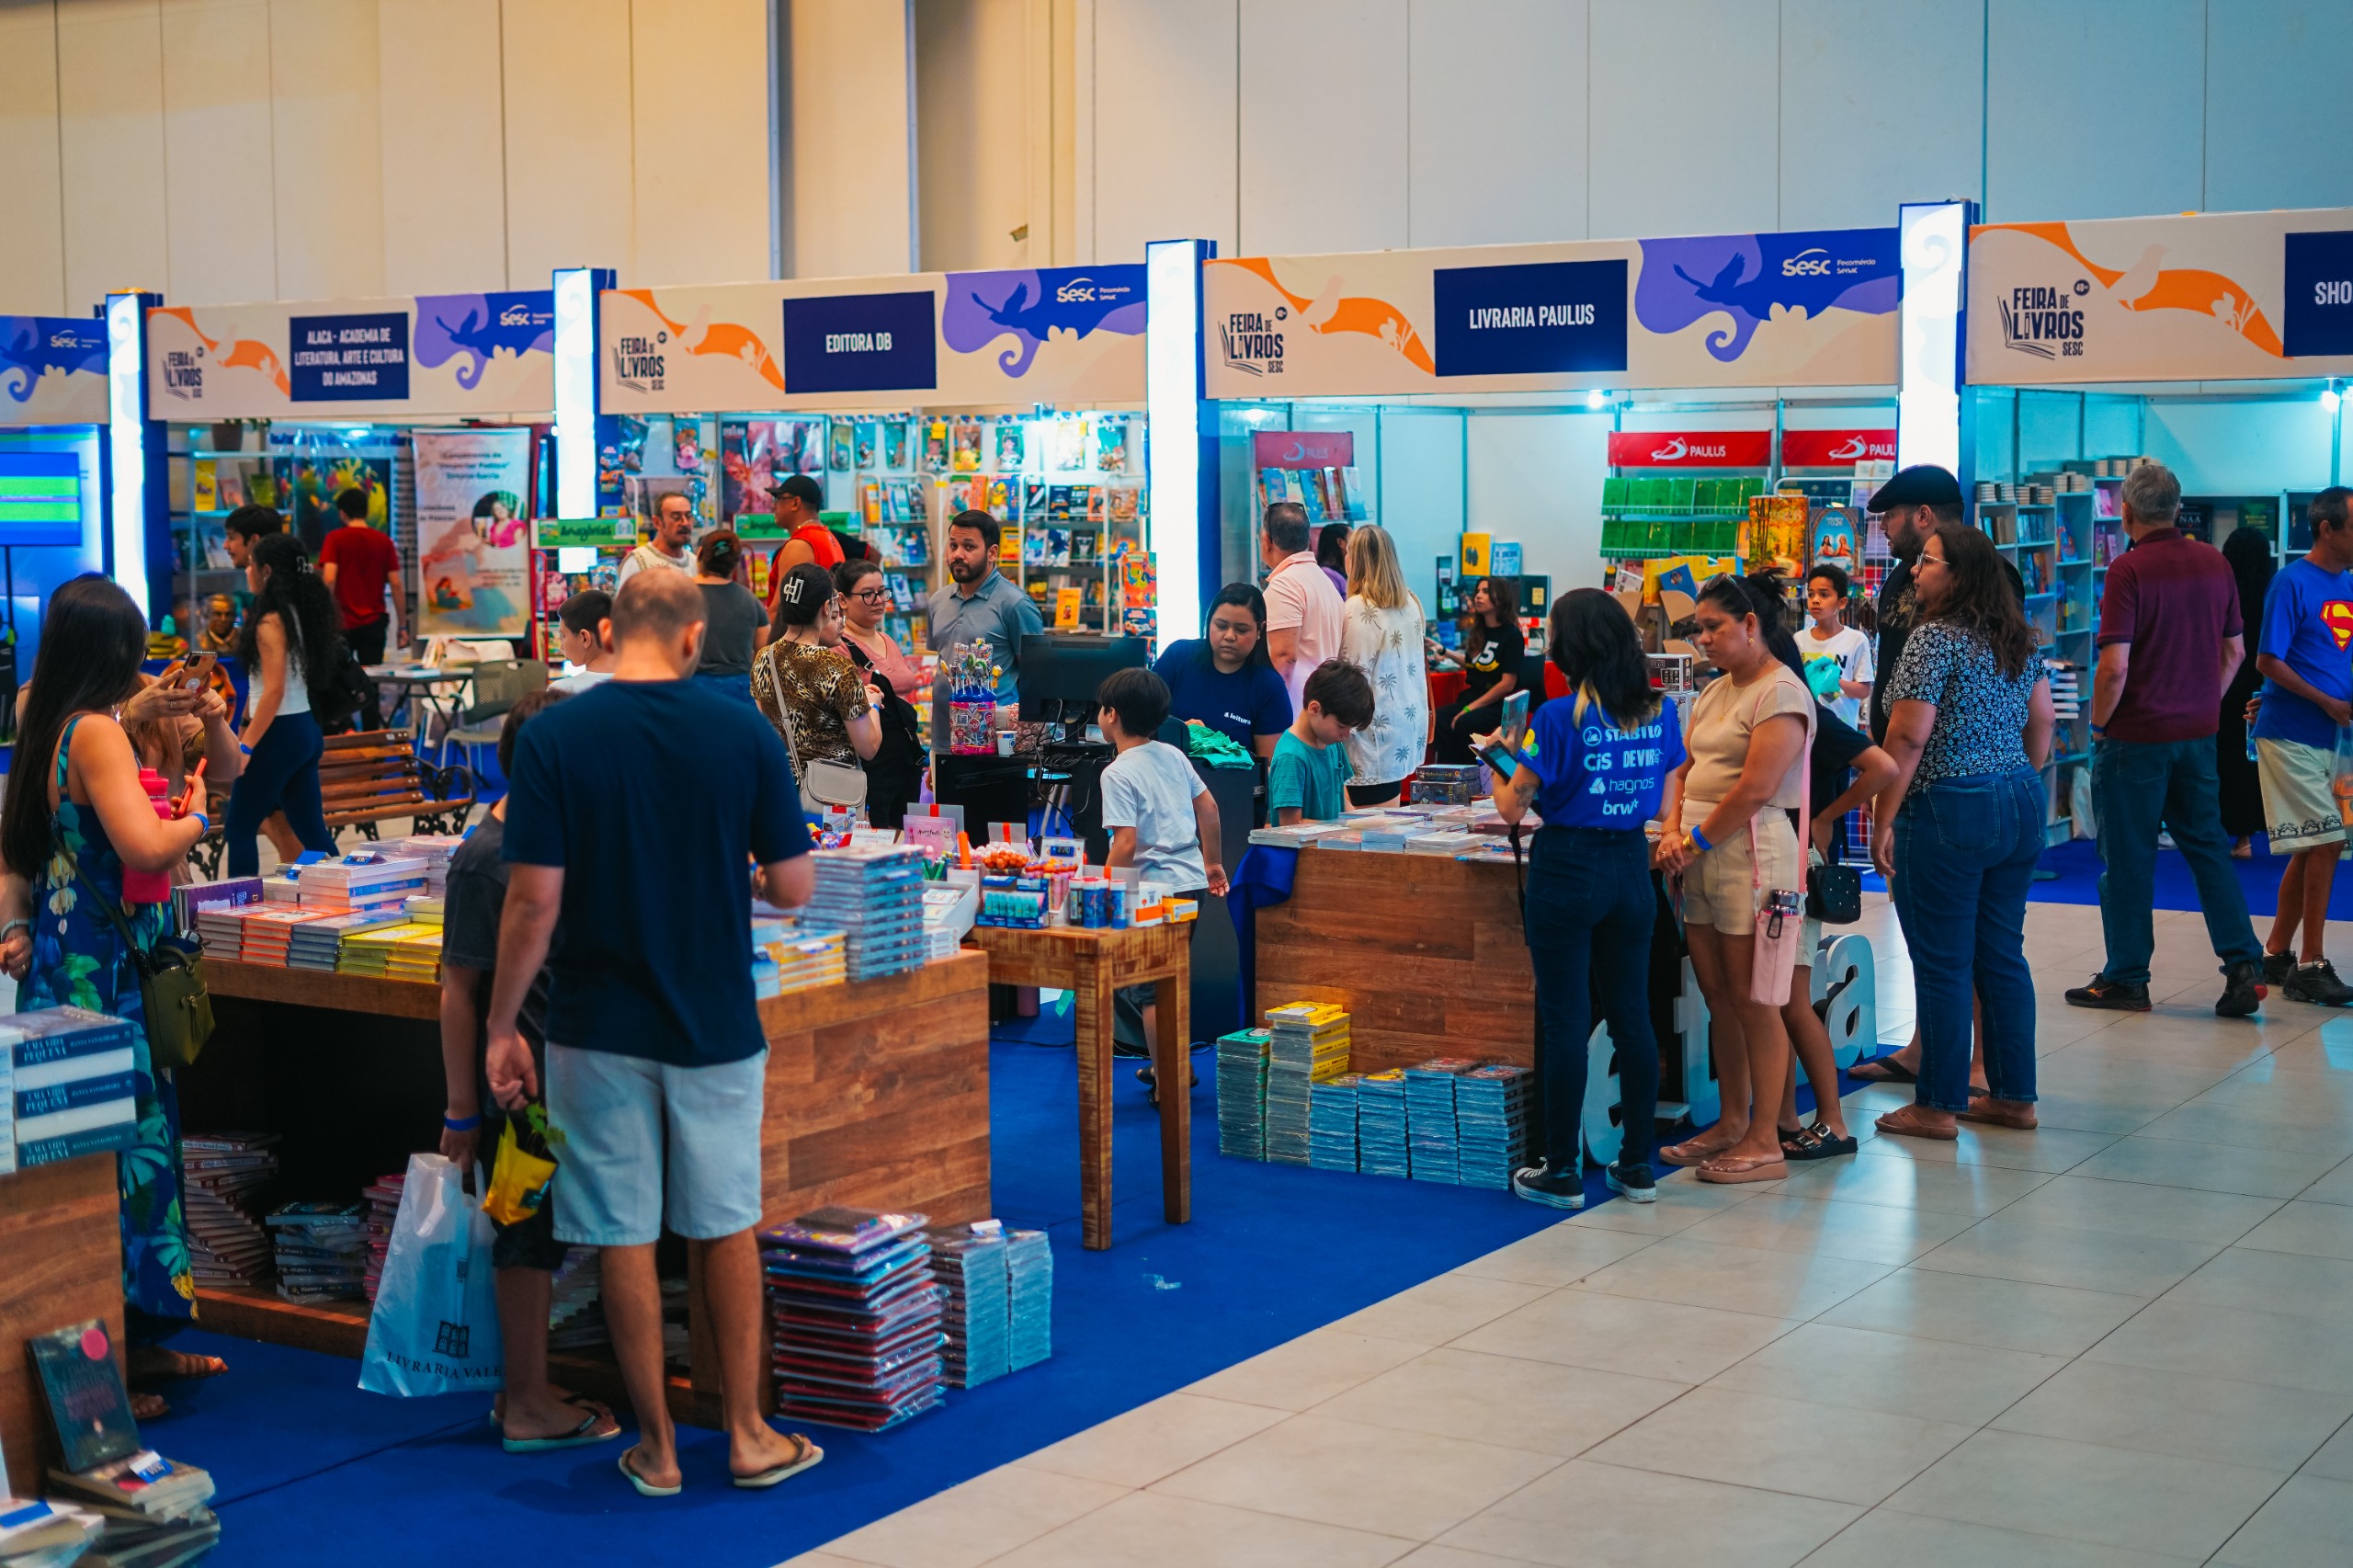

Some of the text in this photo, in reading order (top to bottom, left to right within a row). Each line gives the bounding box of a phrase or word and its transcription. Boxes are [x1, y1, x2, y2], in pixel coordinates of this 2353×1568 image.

[1781, 253, 1831, 276] Sesc
[1056, 282, 1096, 302] Sesc
[2013, 287, 2070, 310] FEIRA DE
[2314, 280, 2353, 305] SHO
[1230, 312, 1263, 333] FEIRA
[1470, 304, 1595, 329] LIVRARIA PAULUS
[2013, 311, 2085, 339] LIVROS
[339, 329, 379, 344] ACADEMIA
[381, 328, 391, 341] DE
[621, 336, 647, 355] FEIRA
[826, 332, 892, 353] EDITORA DB
[1231, 334, 1283, 358] LIVROS
[2063, 341, 2083, 356] SESC
[343, 350, 361, 364] ARTE
[363, 351, 369, 363] E
[369, 348, 404, 364] CULTURA
[621, 356, 665, 378] LIVROS
[168, 369, 202, 387] LIVROS
[323, 370, 378, 386] DO AMAZONAS
[1689, 445, 1726, 458] PAULUS
[1870, 443, 1896, 457] PAUL
[1230, 712, 1251, 725] leitura
[1623, 749, 1654, 768] DEVIR
[1609, 778, 1654, 794] hagnos
[1602, 800, 1634, 815] brw
[386, 1352, 502, 1379] LIVRARIA VALE
